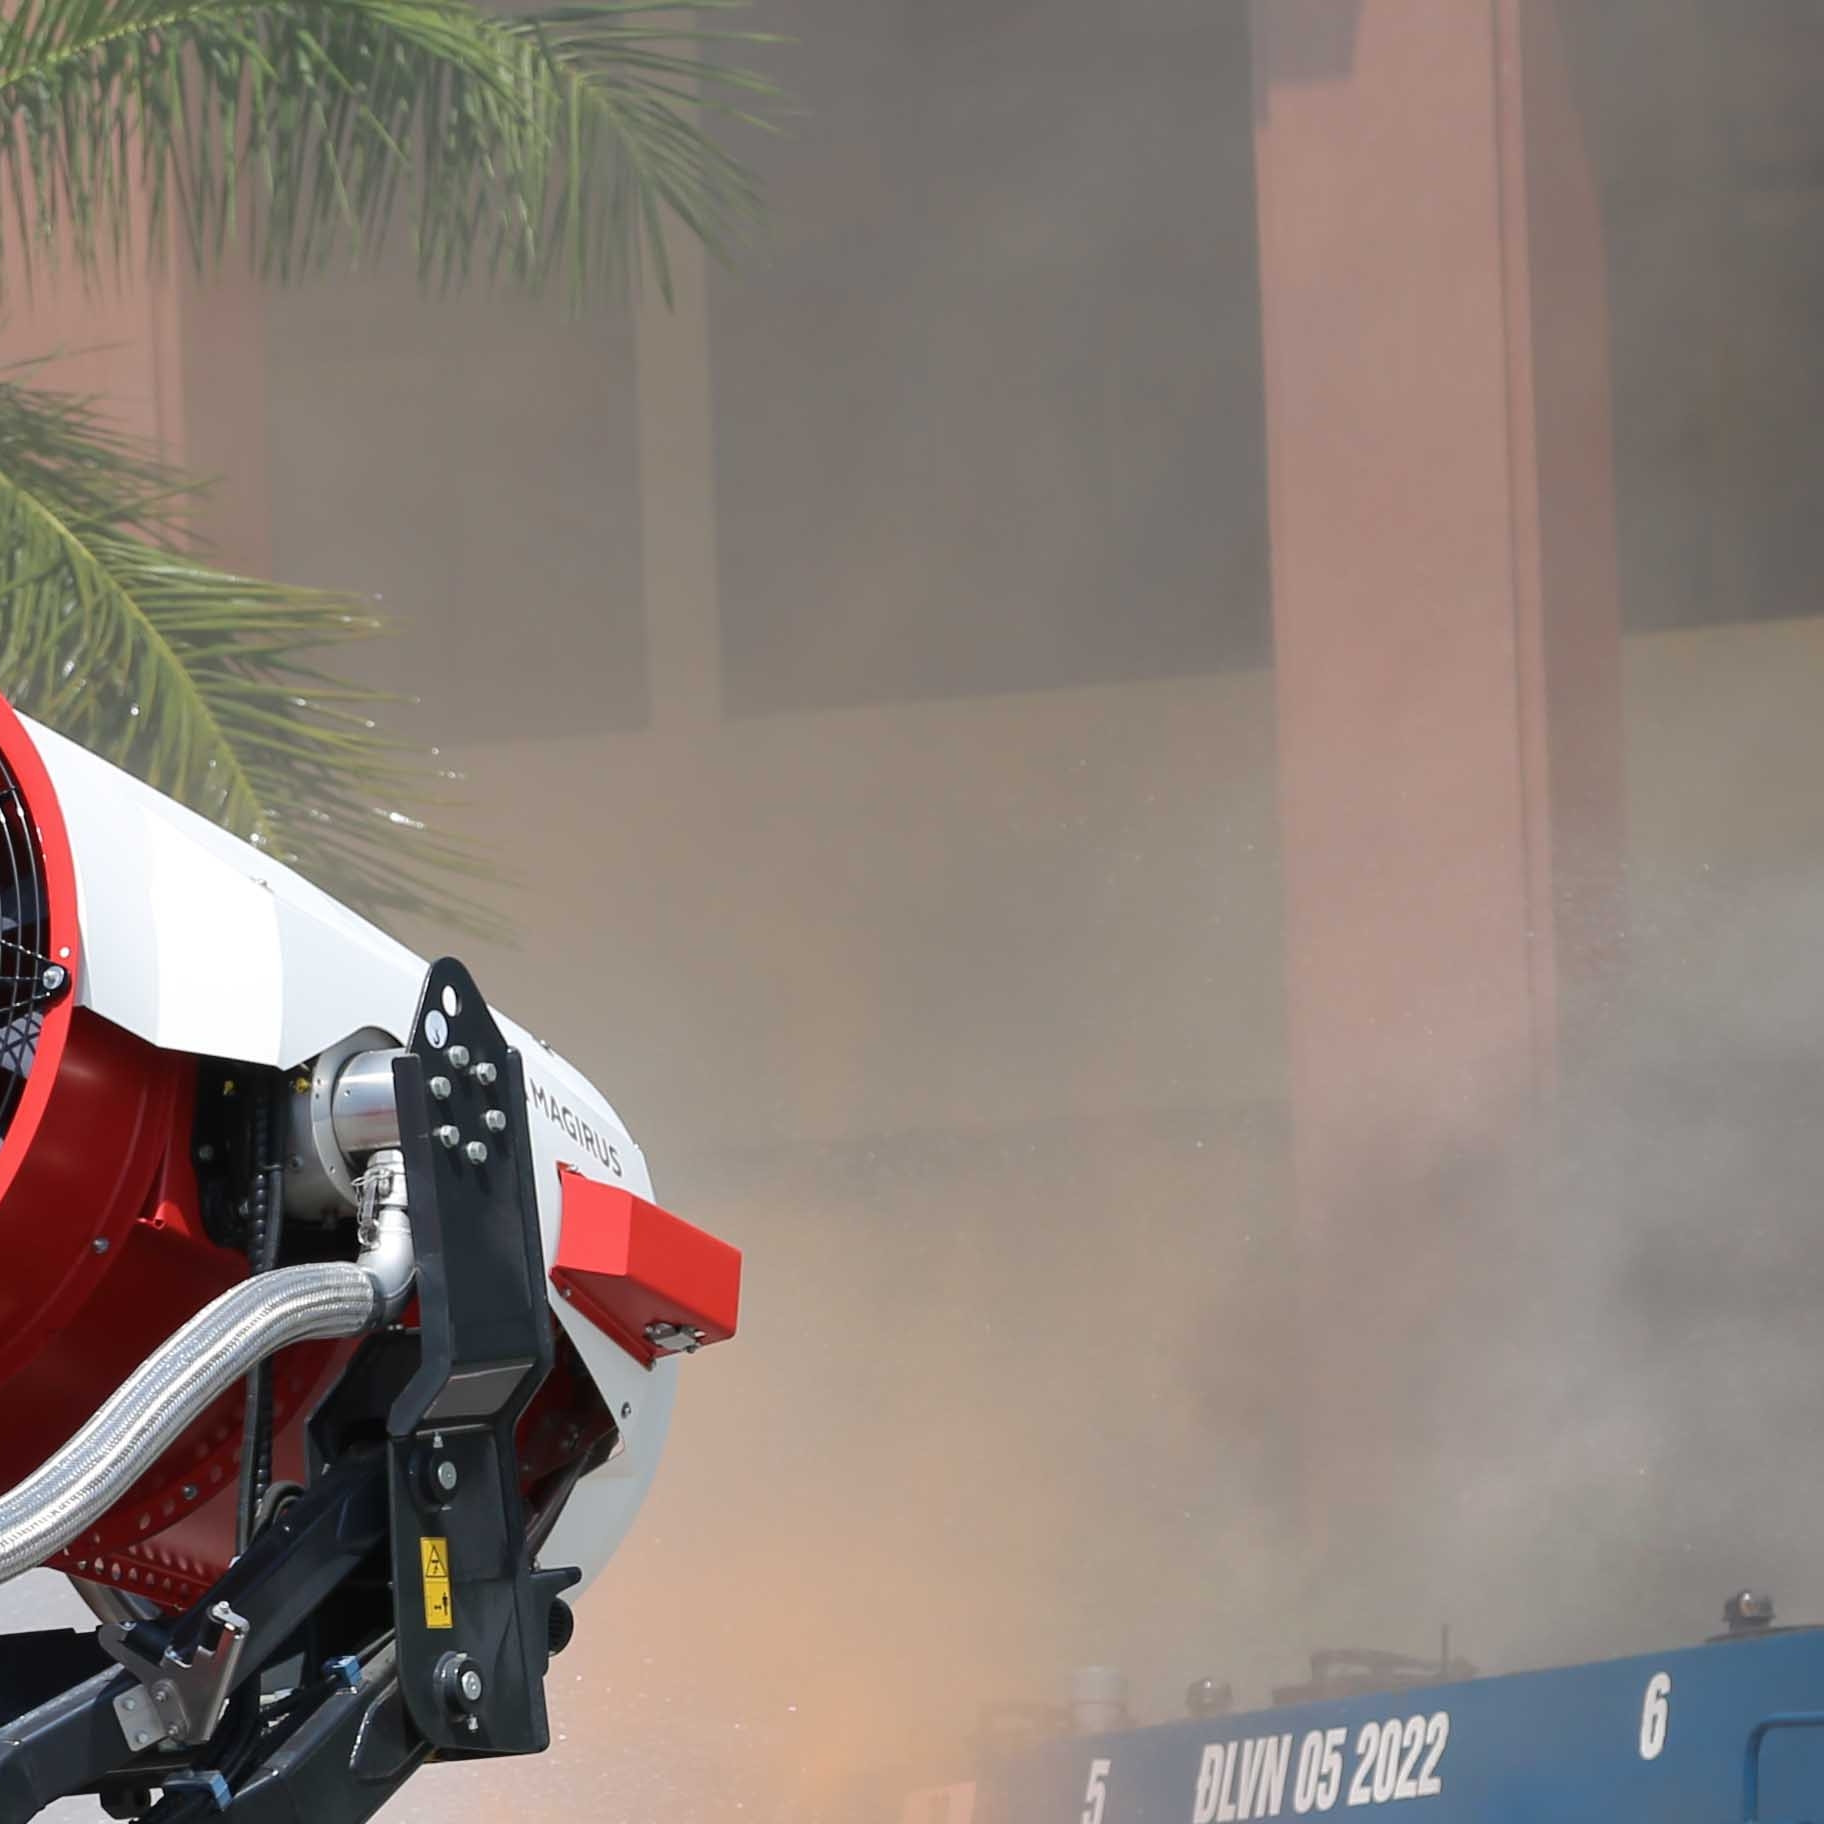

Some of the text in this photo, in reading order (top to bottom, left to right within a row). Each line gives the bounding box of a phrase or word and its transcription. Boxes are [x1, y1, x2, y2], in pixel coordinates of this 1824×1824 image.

[529, 1078, 622, 1178] MAGIRUS
[1293, 1727, 1347, 1815] 05
[1346, 1711, 1450, 1808] 2022
[1639, 1671, 1672, 1761] 6
